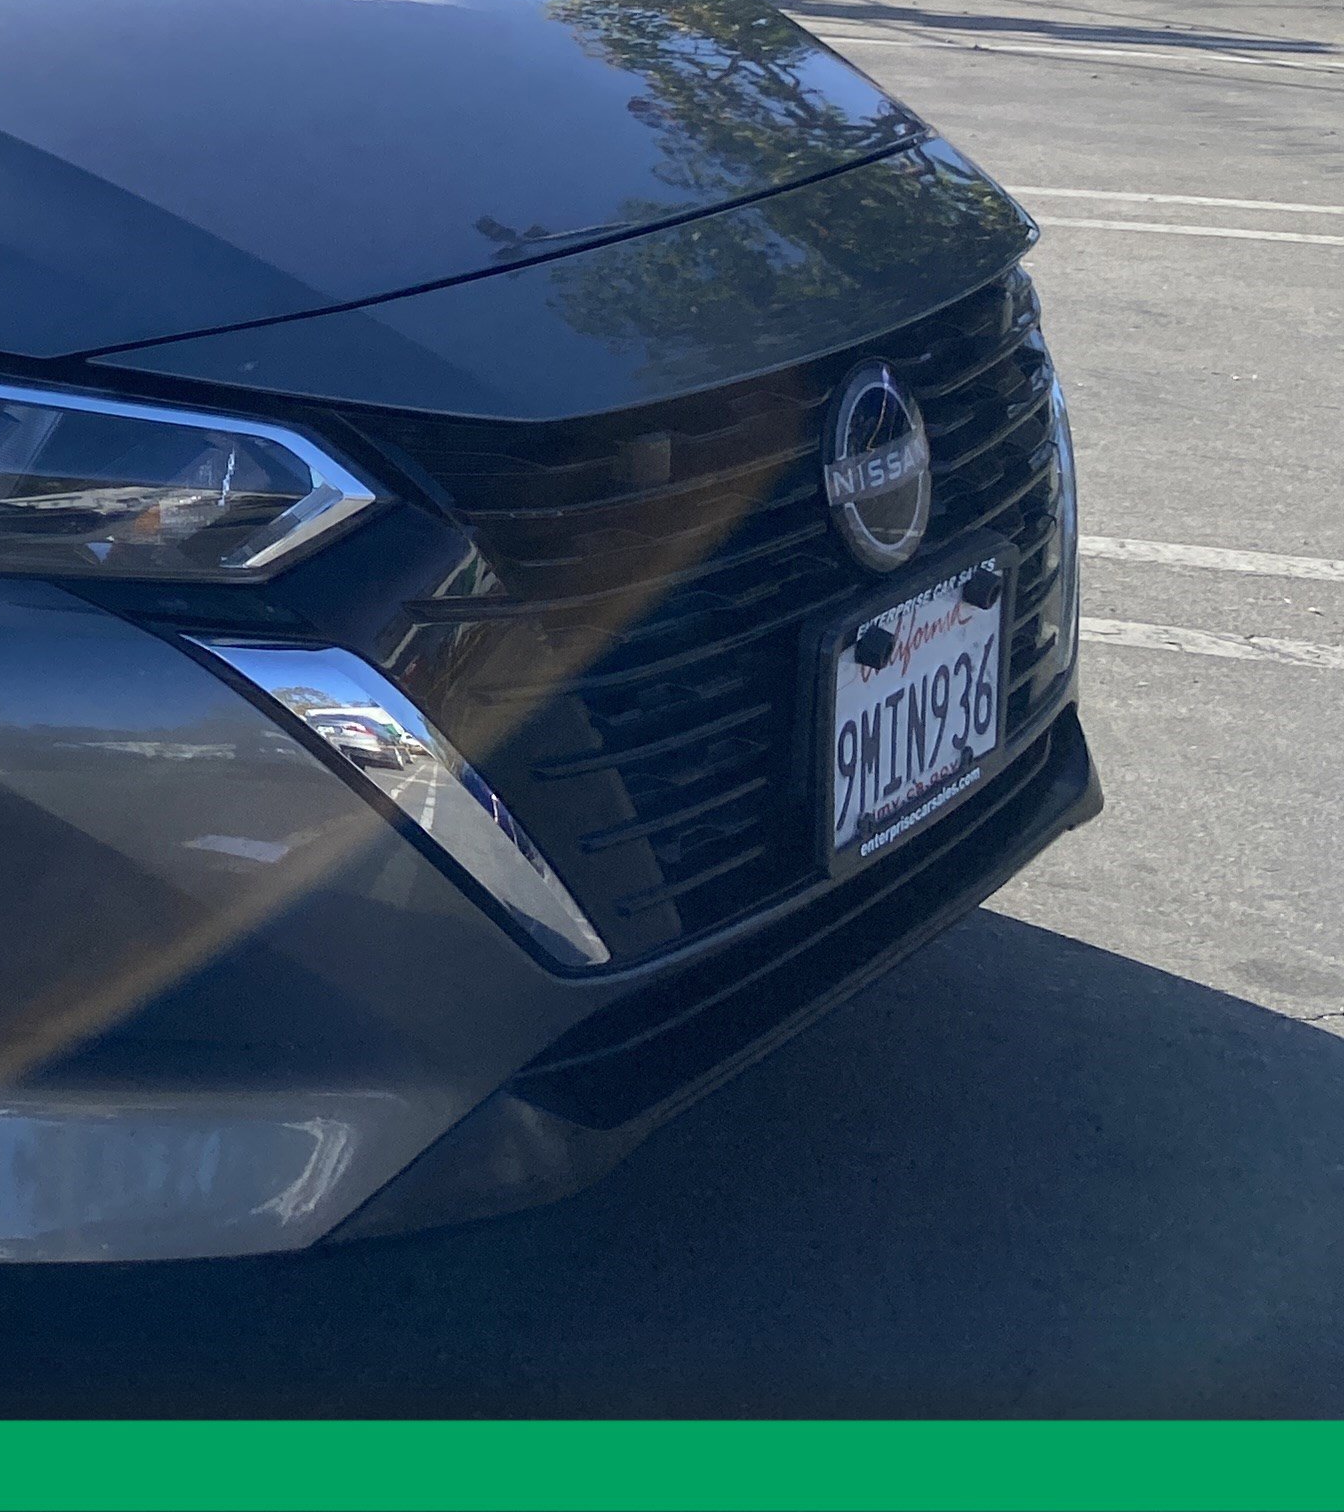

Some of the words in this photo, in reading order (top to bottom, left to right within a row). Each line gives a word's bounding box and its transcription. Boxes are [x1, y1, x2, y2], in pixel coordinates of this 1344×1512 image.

[958, 557, 996, 586] SAES
[861, 598, 973, 683] lifornia
[837, 633, 995, 832] 9MIN936
[861, 767, 981, 857] enterprisecarsales.com
[873, 759, 960, 822] mv.ca.gov
